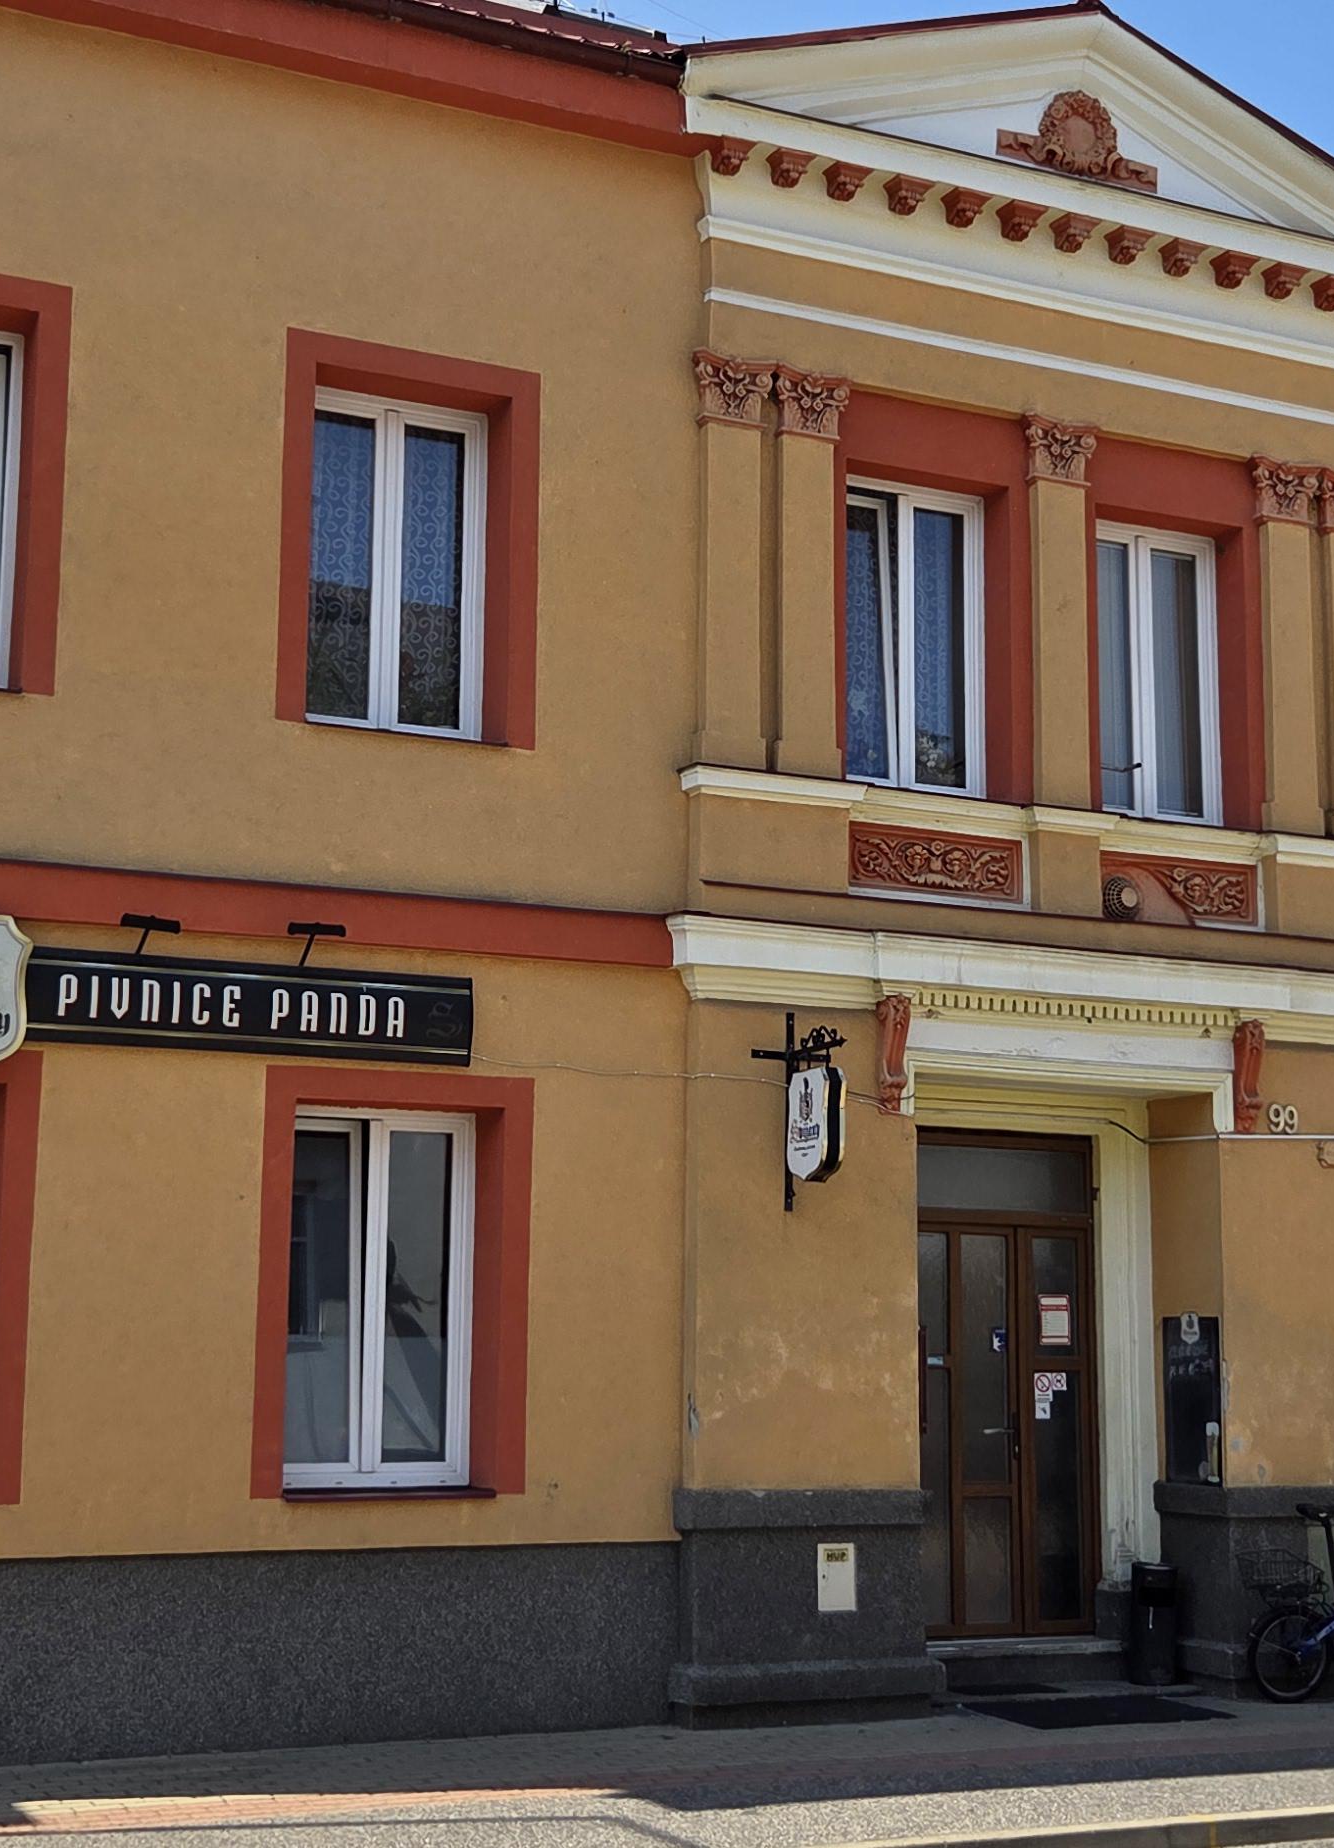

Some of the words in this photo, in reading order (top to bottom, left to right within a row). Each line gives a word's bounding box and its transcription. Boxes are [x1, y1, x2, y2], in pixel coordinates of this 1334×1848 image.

[57, 973, 242, 1027] PIVNICE
[270, 988, 406, 1038] PANDA
[1269, 1103, 1298, 1134] 99
